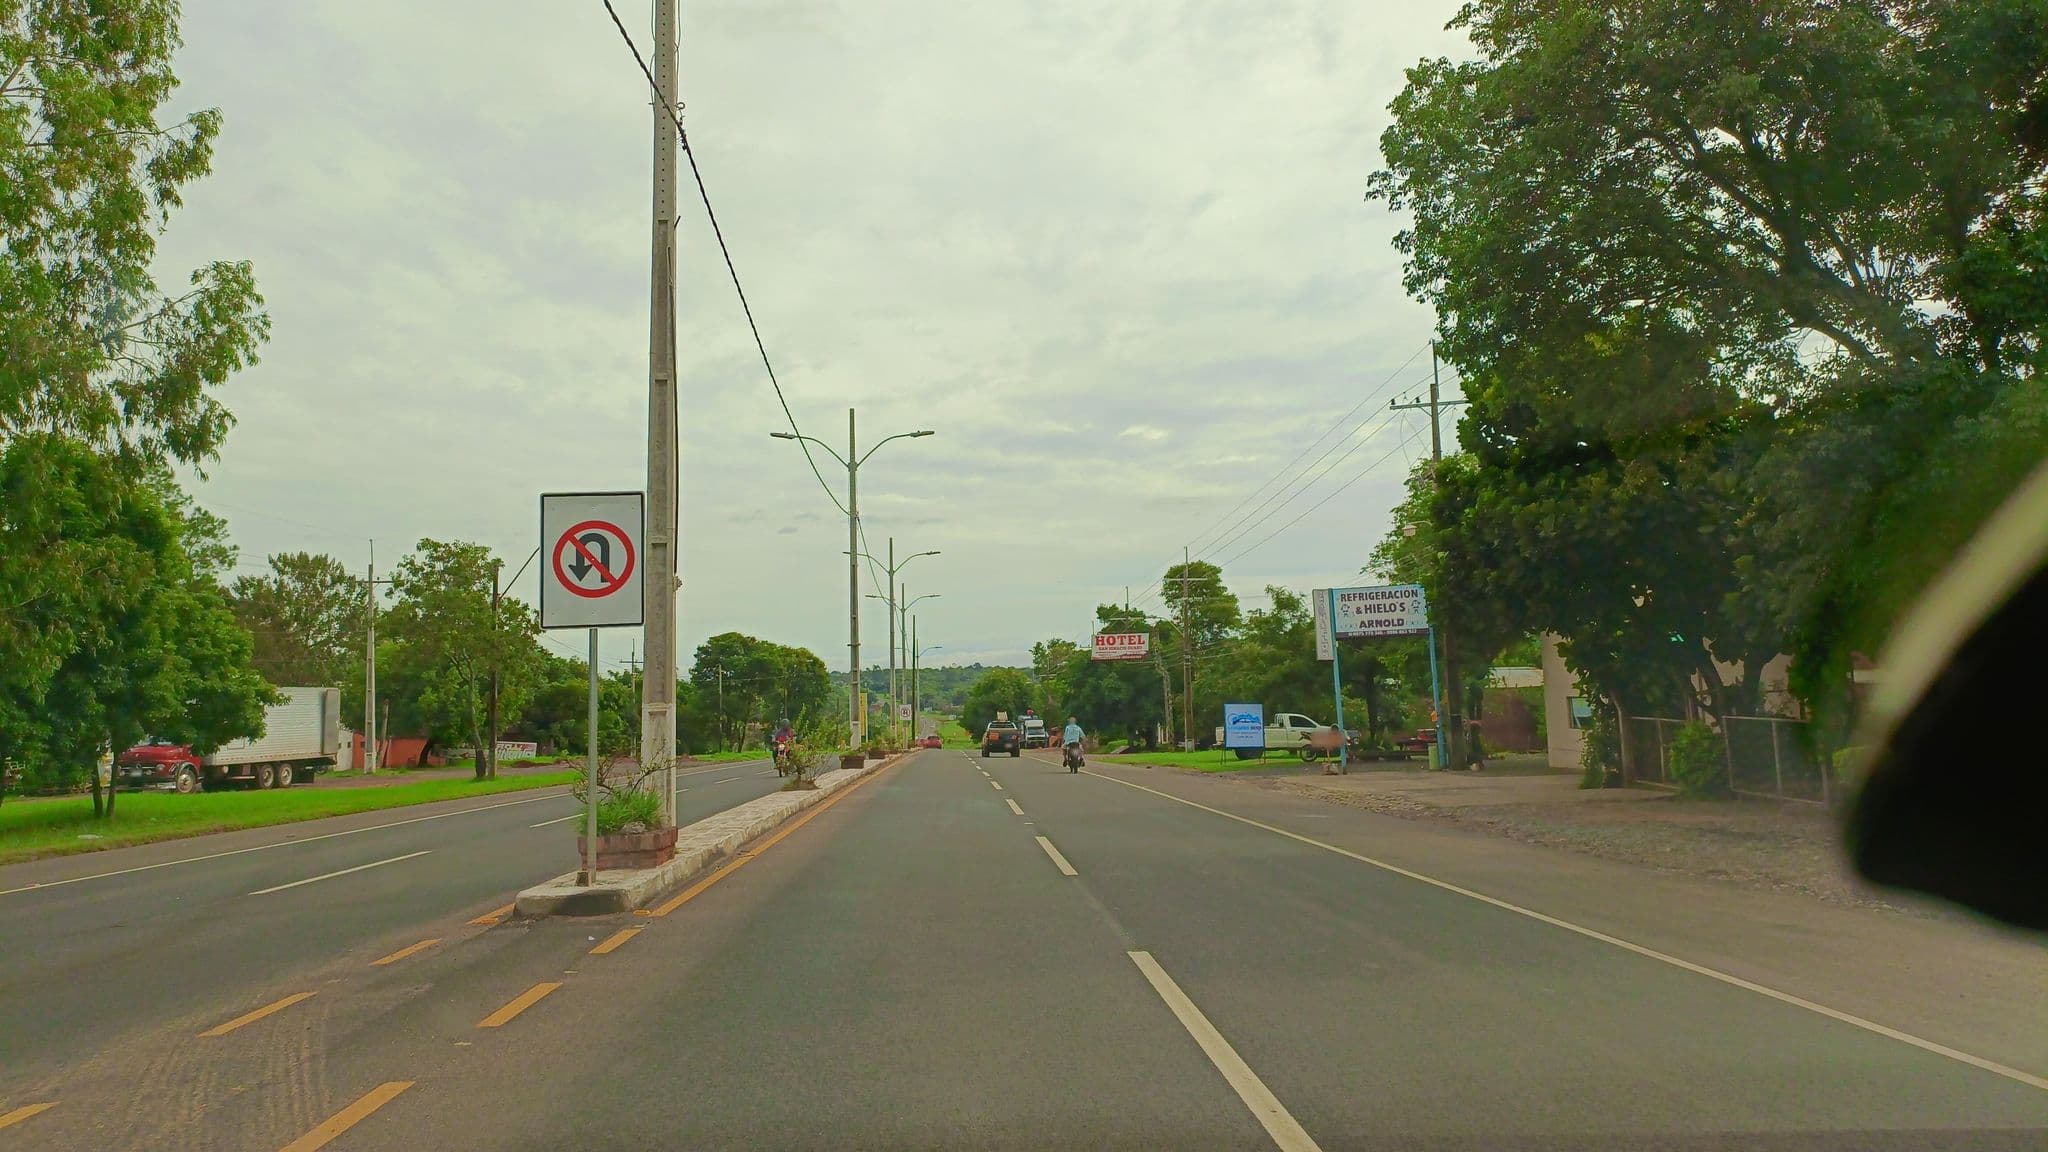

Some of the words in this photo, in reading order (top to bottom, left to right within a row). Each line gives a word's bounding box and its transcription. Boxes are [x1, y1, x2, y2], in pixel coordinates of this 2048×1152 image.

[1340, 588, 1418, 602] REFRIGERACIÓN
[1355, 606, 1362, 614] &
[1359, 618, 1405, 629] ARNOLD
[1095, 635, 1145, 646] HOTEL
